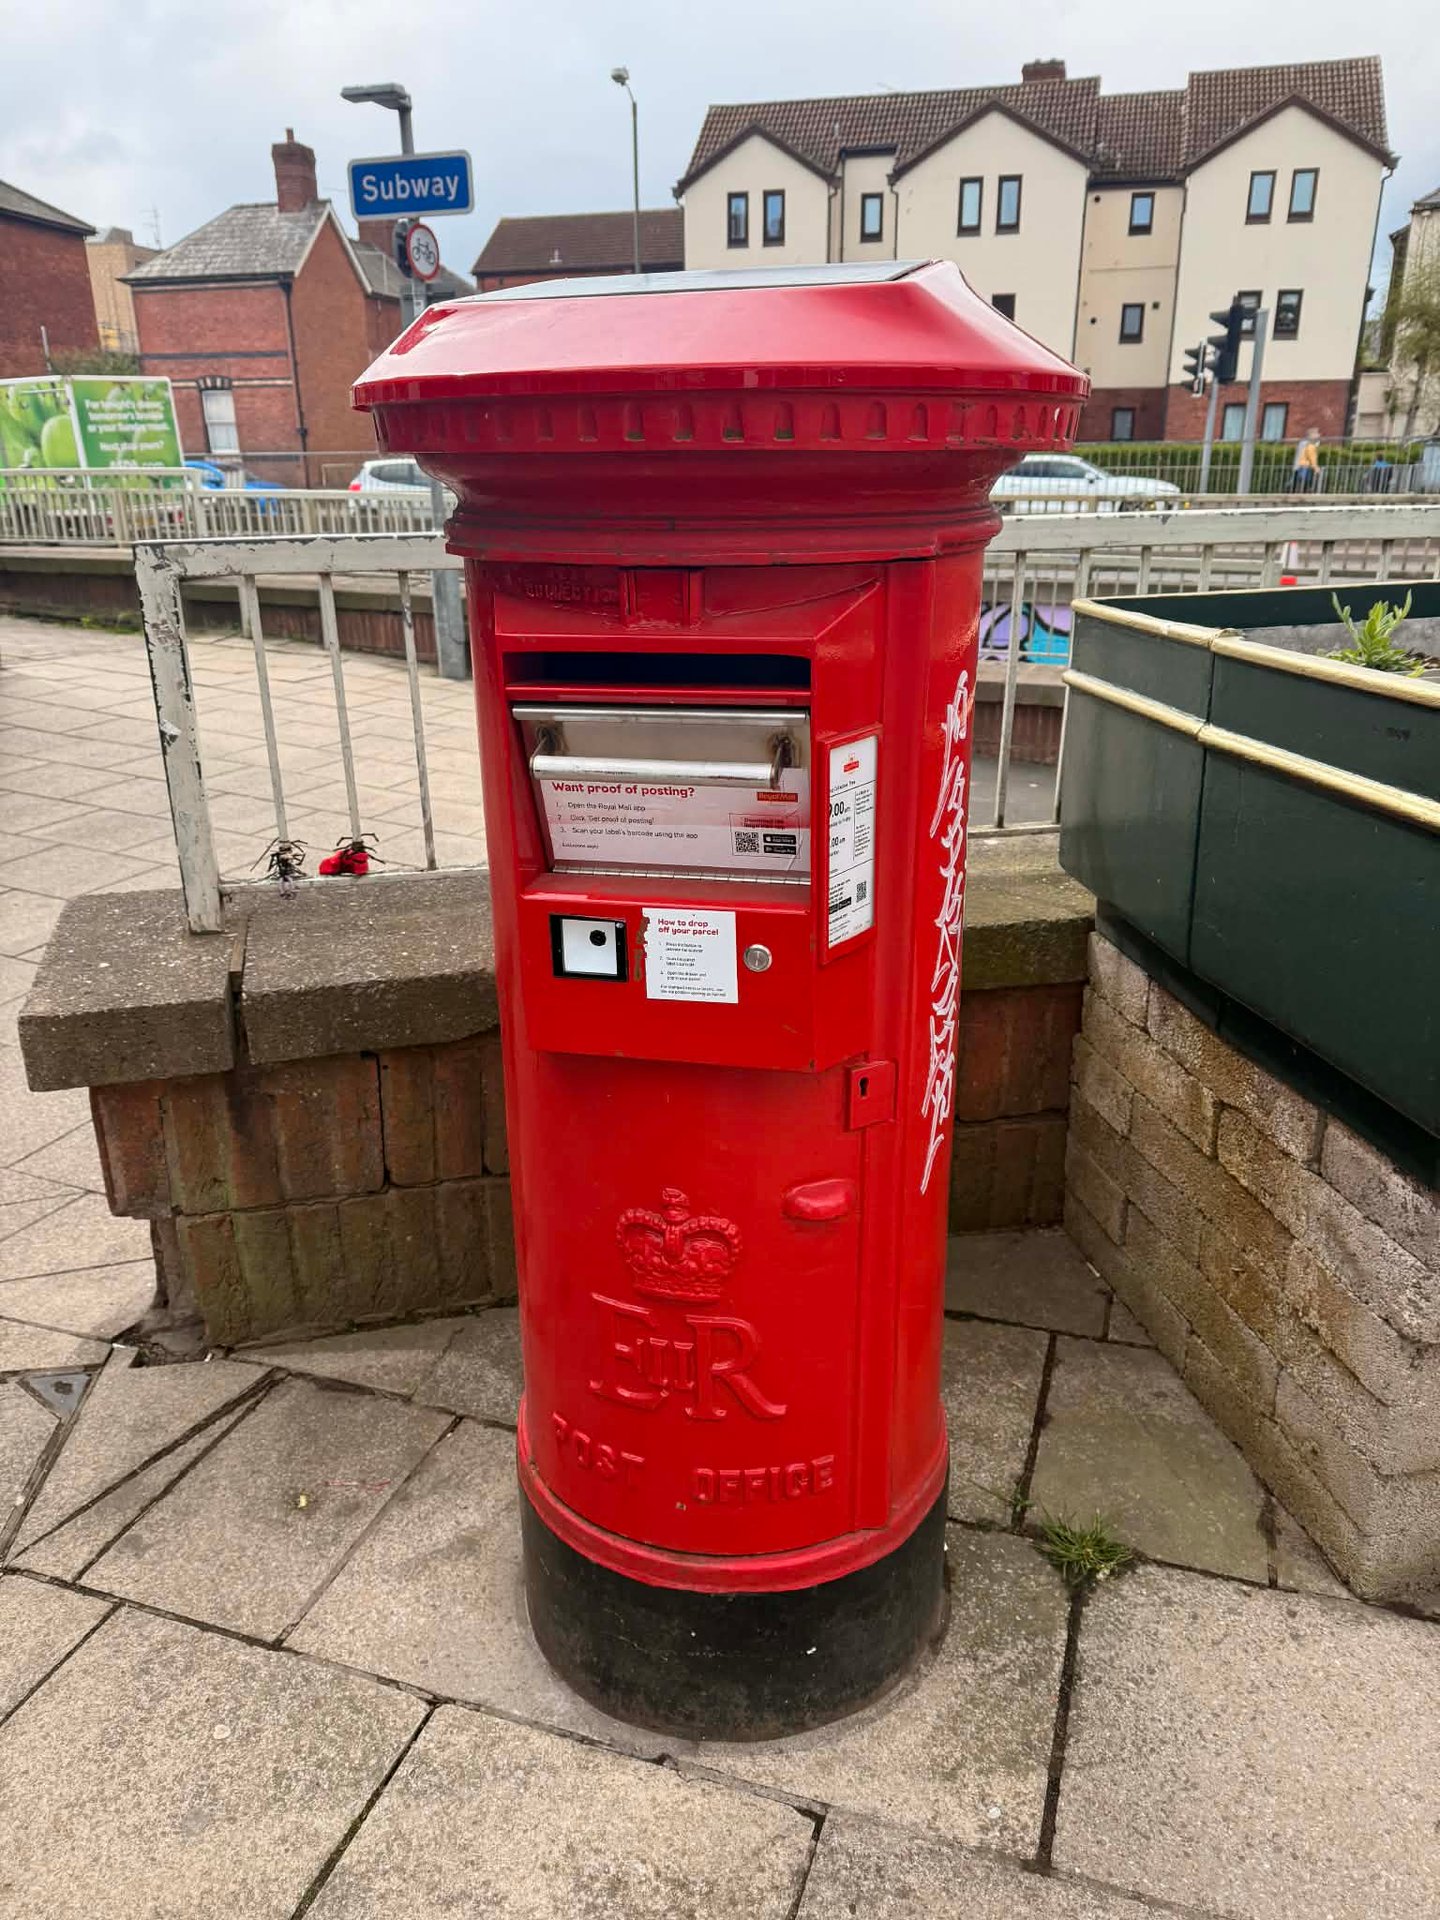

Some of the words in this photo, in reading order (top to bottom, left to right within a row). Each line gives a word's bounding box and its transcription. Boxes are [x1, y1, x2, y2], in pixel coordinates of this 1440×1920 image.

[362, 173, 459, 202] Subway
[552, 782, 584, 793] Want
[588, 784, 622, 795] proof
[625, 785, 637, 794] of
[642, 787, 695, 799] posting?
[567, 801, 585, 810] Open
[598, 803, 616, 811] Royal
[601, 814, 619, 823] proof
[590, 828, 603, 836] your
[627, 829, 654, 837] barcode
[655, 830, 673, 839] using
[688, 920, 709, 929] drop
[552, 1411, 645, 1490] POST
[693, 1454, 835, 1504] OFFICE
